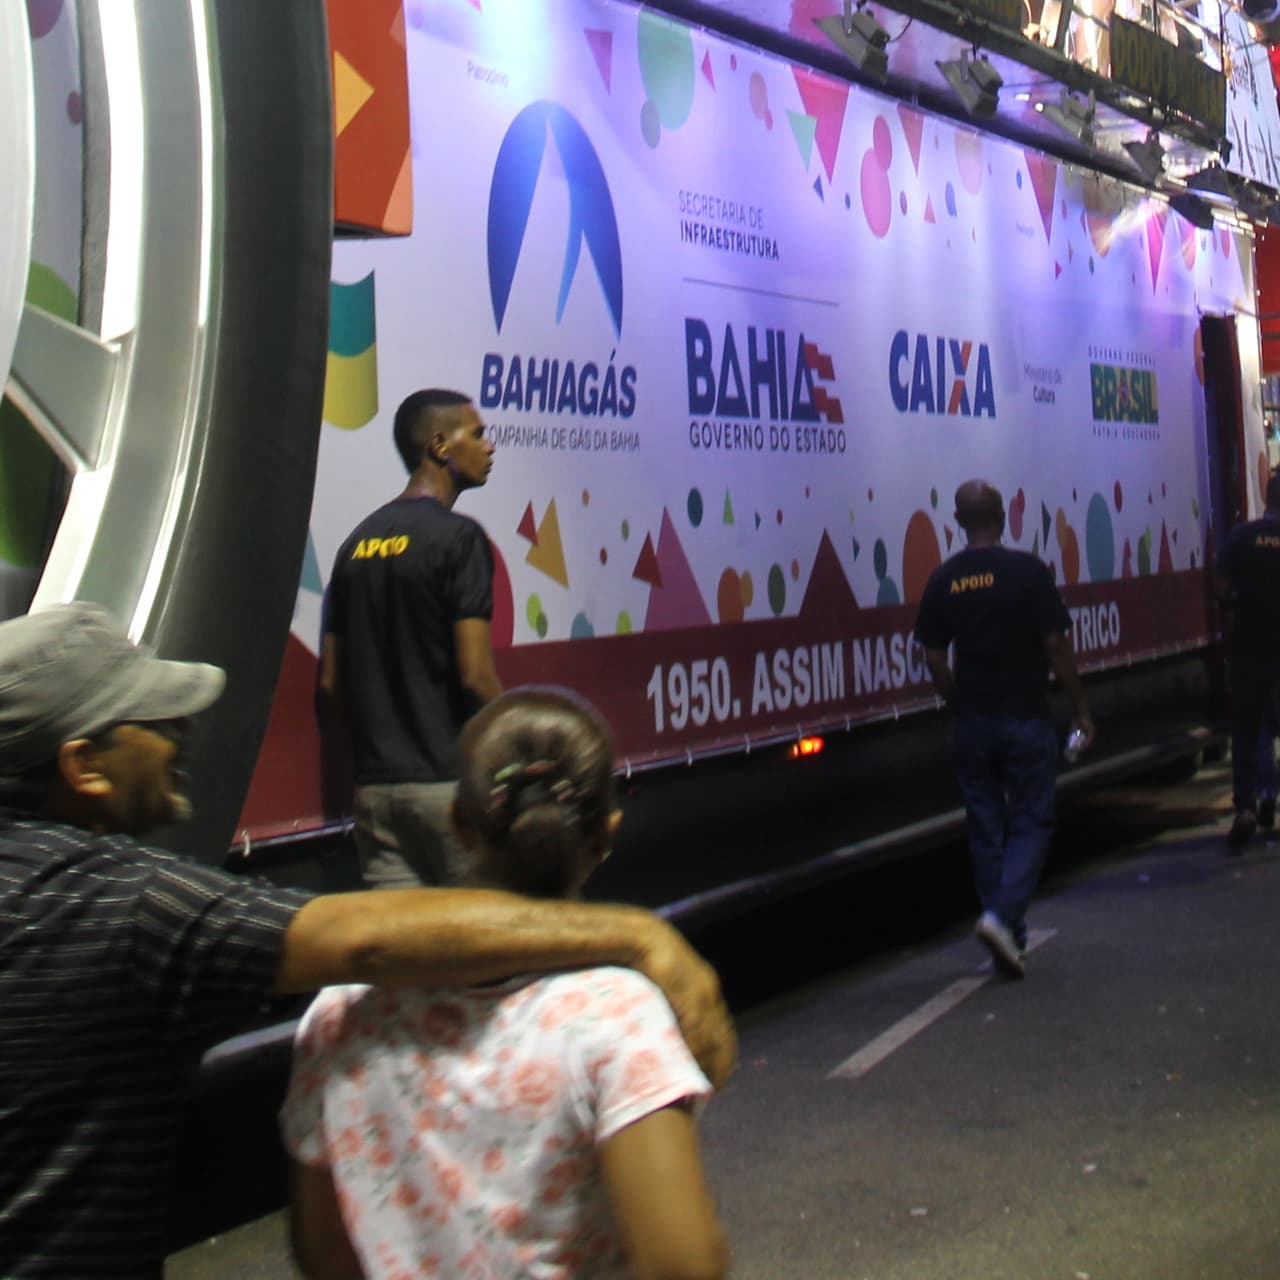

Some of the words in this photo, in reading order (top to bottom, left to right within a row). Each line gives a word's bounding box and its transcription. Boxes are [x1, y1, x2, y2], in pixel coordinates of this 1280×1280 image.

[679, 190, 746, 224] SECRETARIA
[749, 207, 763, 229] DE
[680, 220, 779, 261] INFRAESTRUTURA
[480, 348, 637, 419] BAHIAGÁS
[684, 316, 824, 423] BAHIA
[888, 329, 996, 419] CAIXA
[1090, 363, 1160, 425] BRASIL
[487, 424, 549, 451] OMPANHIA
[551, 427, 567, 450] DE
[593, 432, 608, 452] DA
[610, 432, 641, 453] BAHIA
[689, 422, 764, 452] GOVERNO
[769, 426, 791, 452] DO
[795, 427, 847, 454] ESTADO
[950, 572, 994, 593] APOIO
[647, 656, 742, 733] 1950.
[751, 640, 846, 716] ASSIM
[852, 631, 933, 695] NASC
